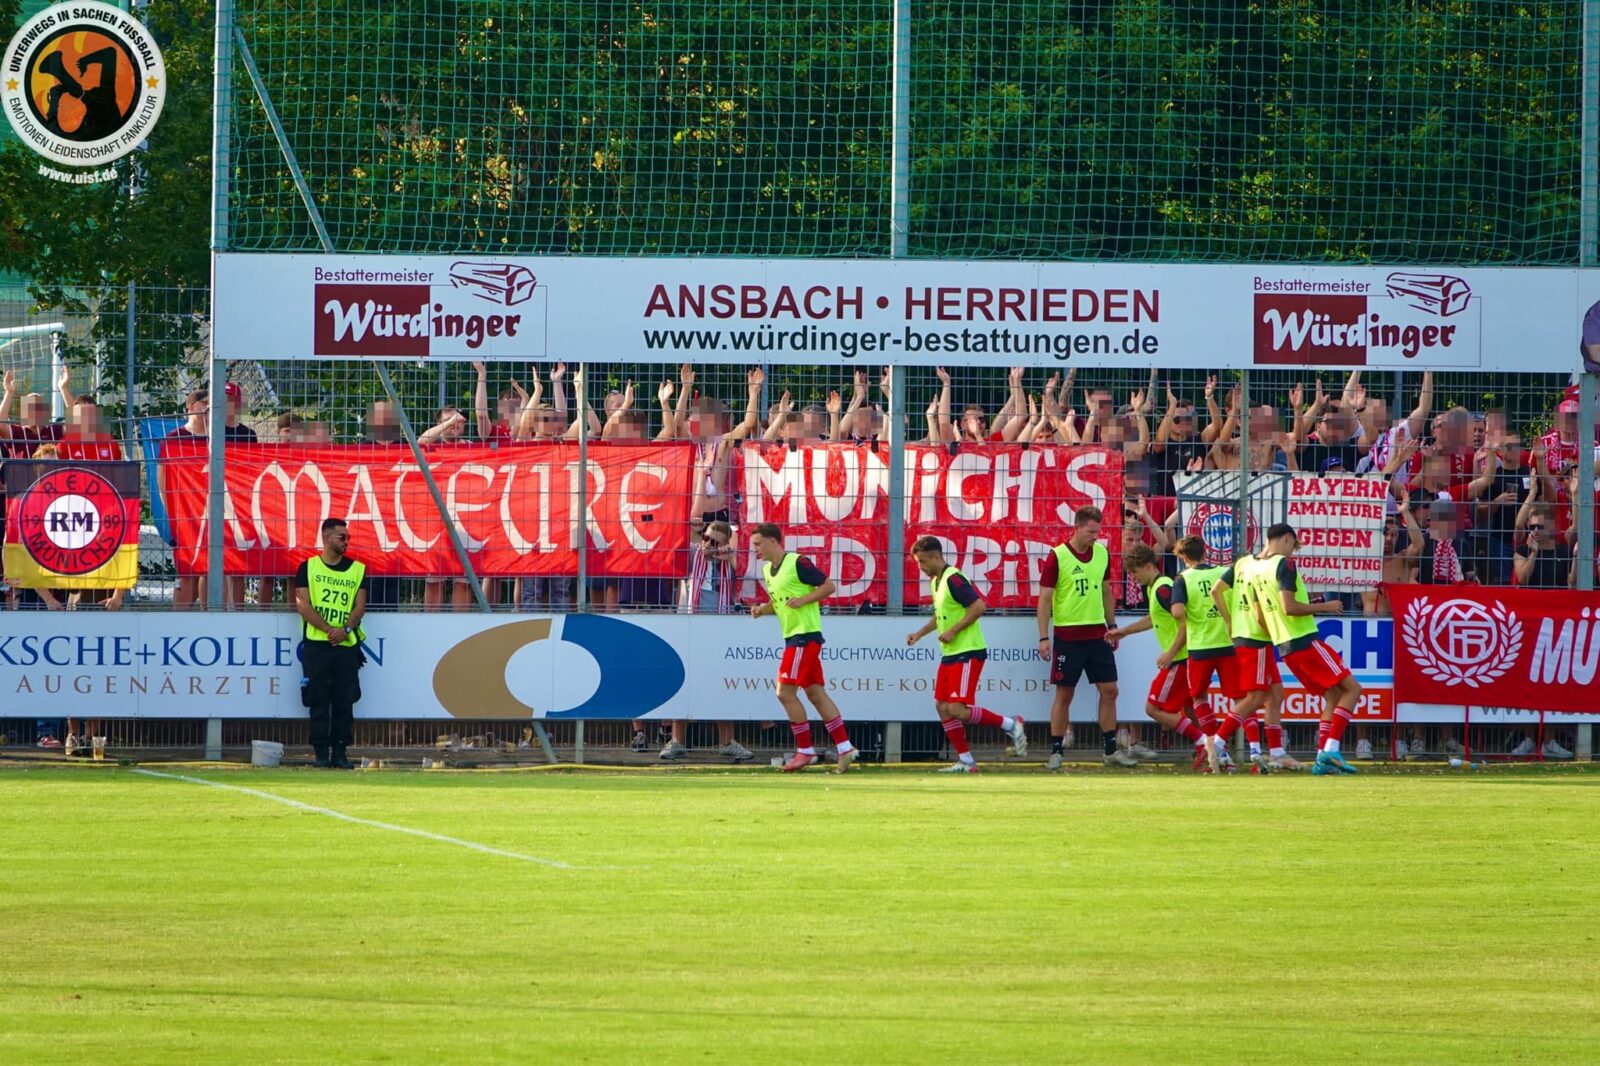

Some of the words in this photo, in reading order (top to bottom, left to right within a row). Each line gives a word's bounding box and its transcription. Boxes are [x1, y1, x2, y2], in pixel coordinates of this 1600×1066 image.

[314, 266, 434, 282] Bestattermeister
[1253, 276, 1371, 293] Bestattermeister
[643, 284, 863, 320] ANSBACH
[904, 287, 1160, 324] HERRIEDEN
[324, 299, 521, 349] Würdinger
[1263, 308, 1456, 358] Würdinger
[643, 324, 1159, 360] www.würdinger-bestattungen.de
[42, 473, 101, 497] RED
[1292, 478, 1388, 500] BAYERN
[50, 511, 94, 532] RM
[191, 458, 668, 567] AMATEURE
[1288, 501, 1383, 520] AMATEURE
[1297, 528, 1373, 548] GEGEN
[28, 531, 115, 569] MUNICHS
[315, 575, 357, 589] STEWARD
[321, 588, 349, 606] 279
[725, 646, 783, 660] ANSBAC
[821, 647, 935, 661] EUCHTWANGEN
[16, 672, 281, 695] AUGENÄRZTE
